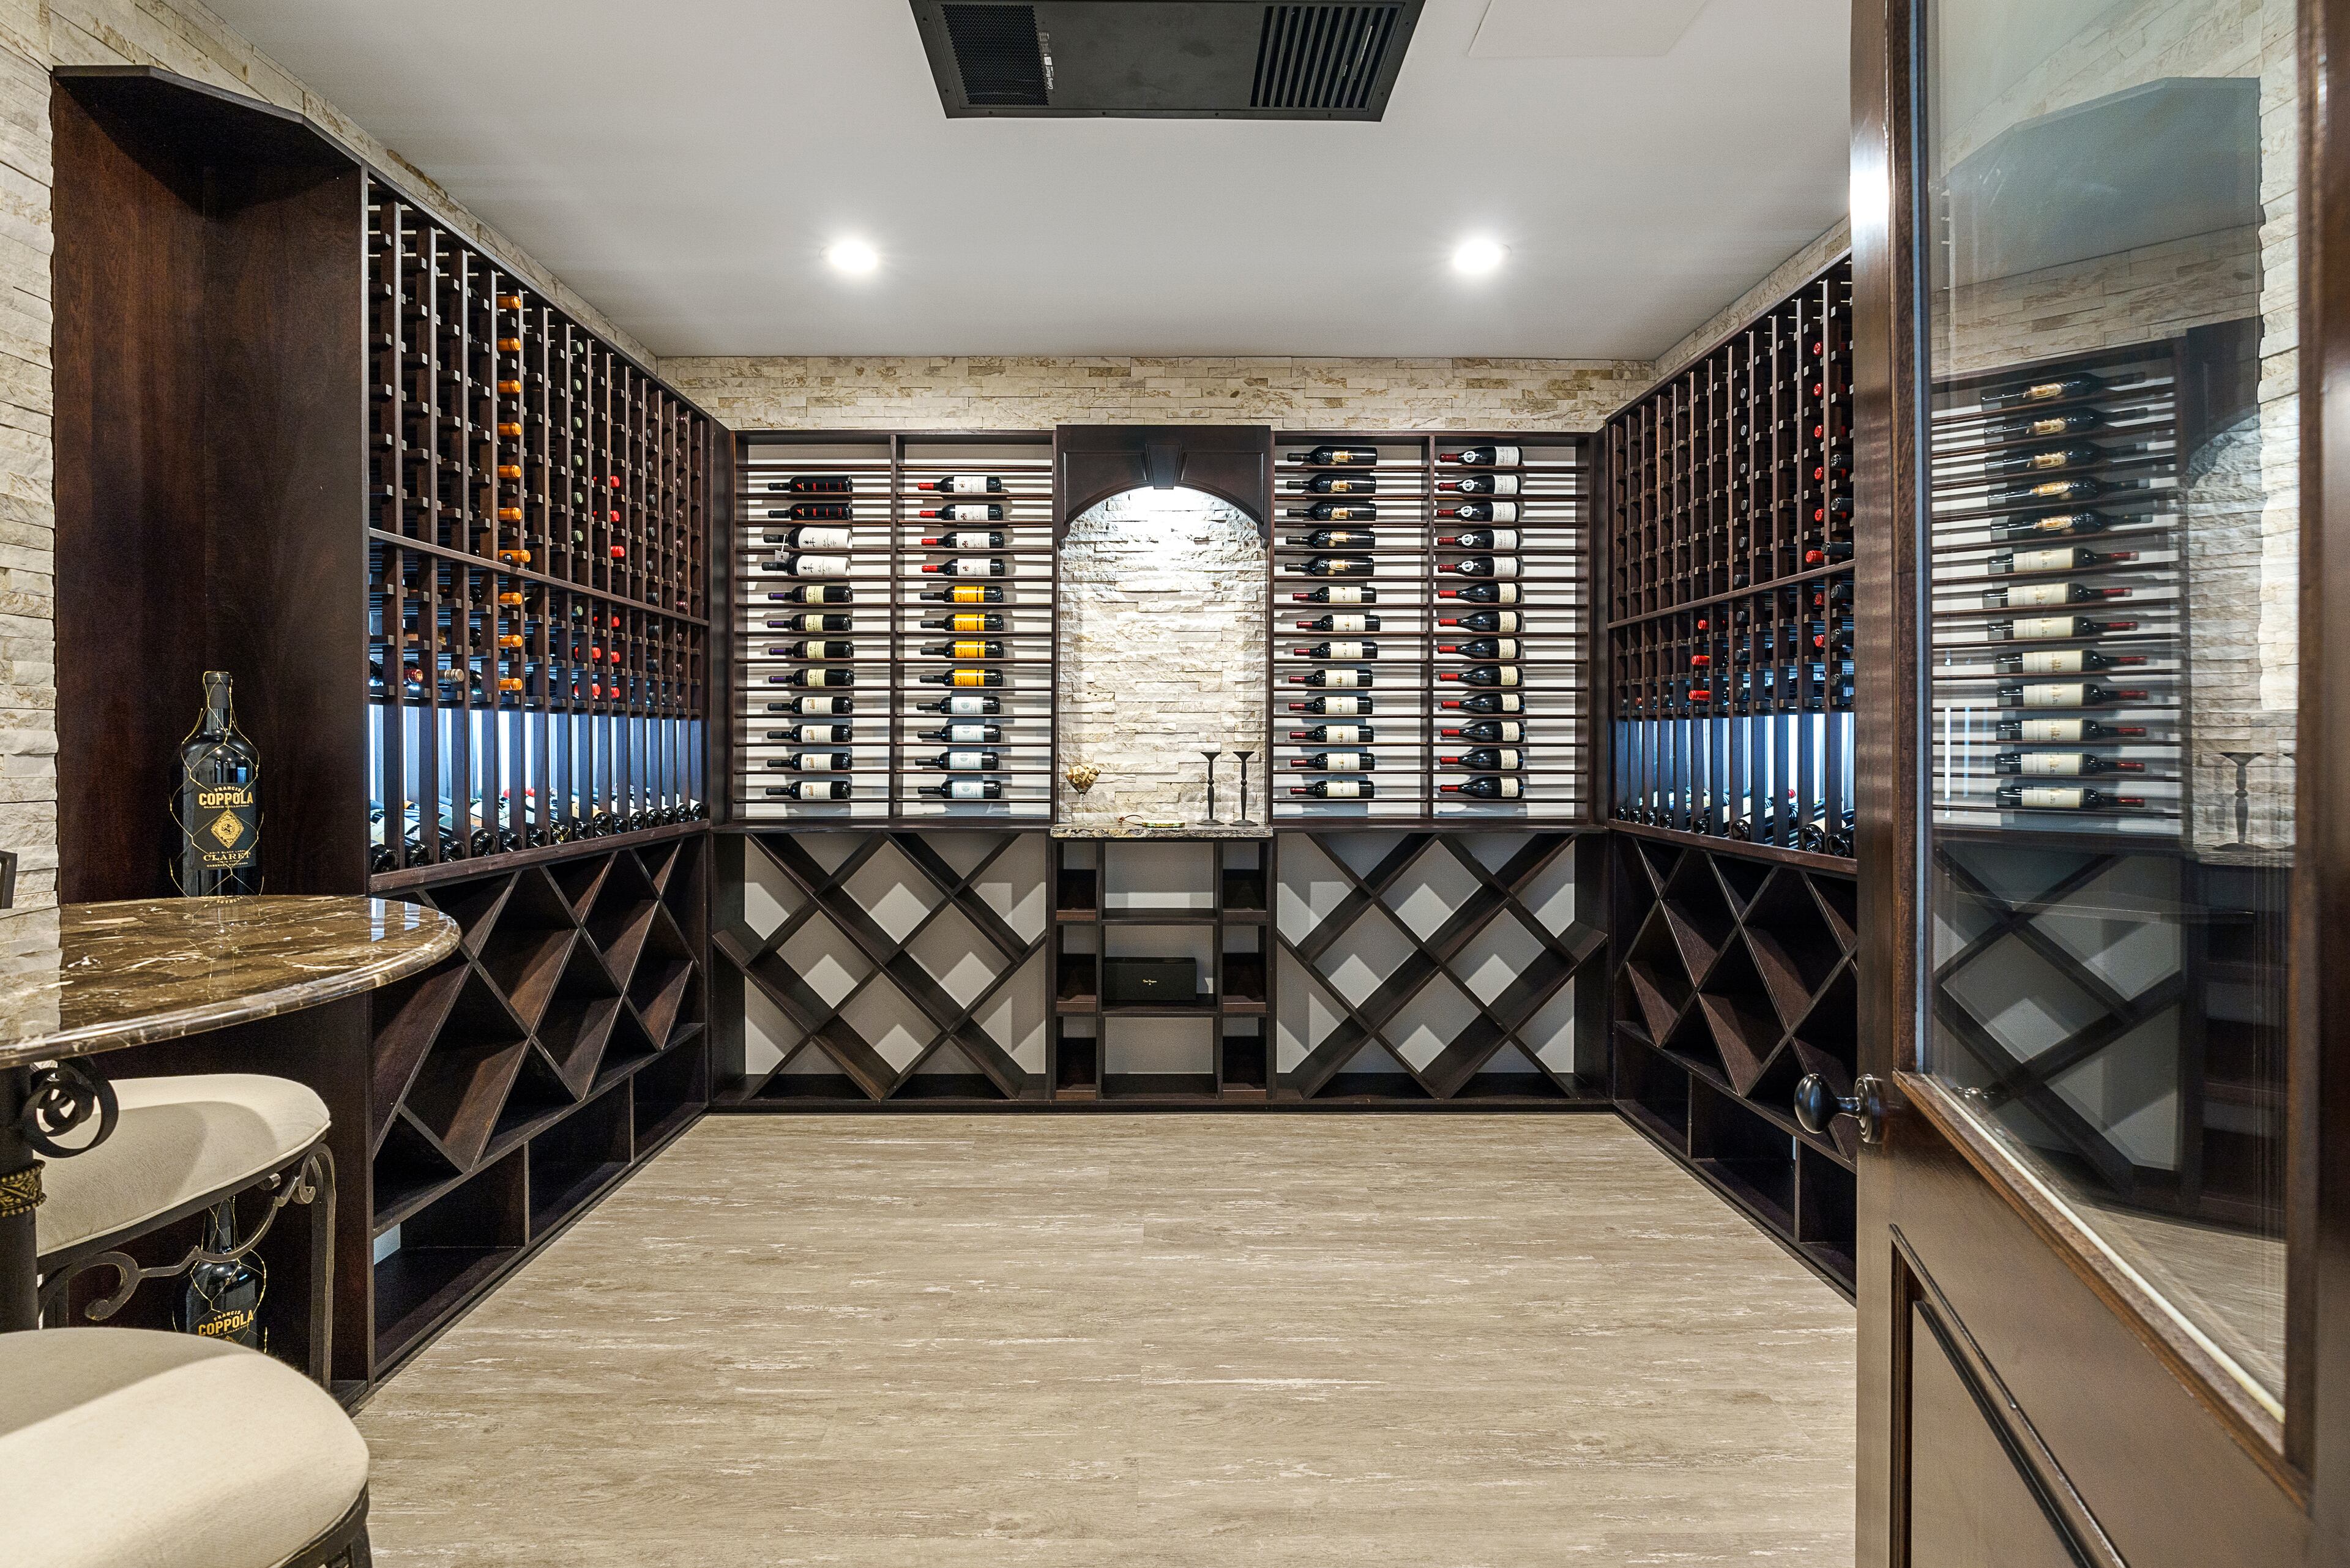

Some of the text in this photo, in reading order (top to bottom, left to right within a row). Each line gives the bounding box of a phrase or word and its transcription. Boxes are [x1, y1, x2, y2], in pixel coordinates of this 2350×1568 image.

[198, 791, 253, 806] COPPOLA
[203, 853, 251, 862] CLARET
[214, 1310, 241, 1321] FRANCIS
[198, 1310, 254, 1336] COPPOLA
